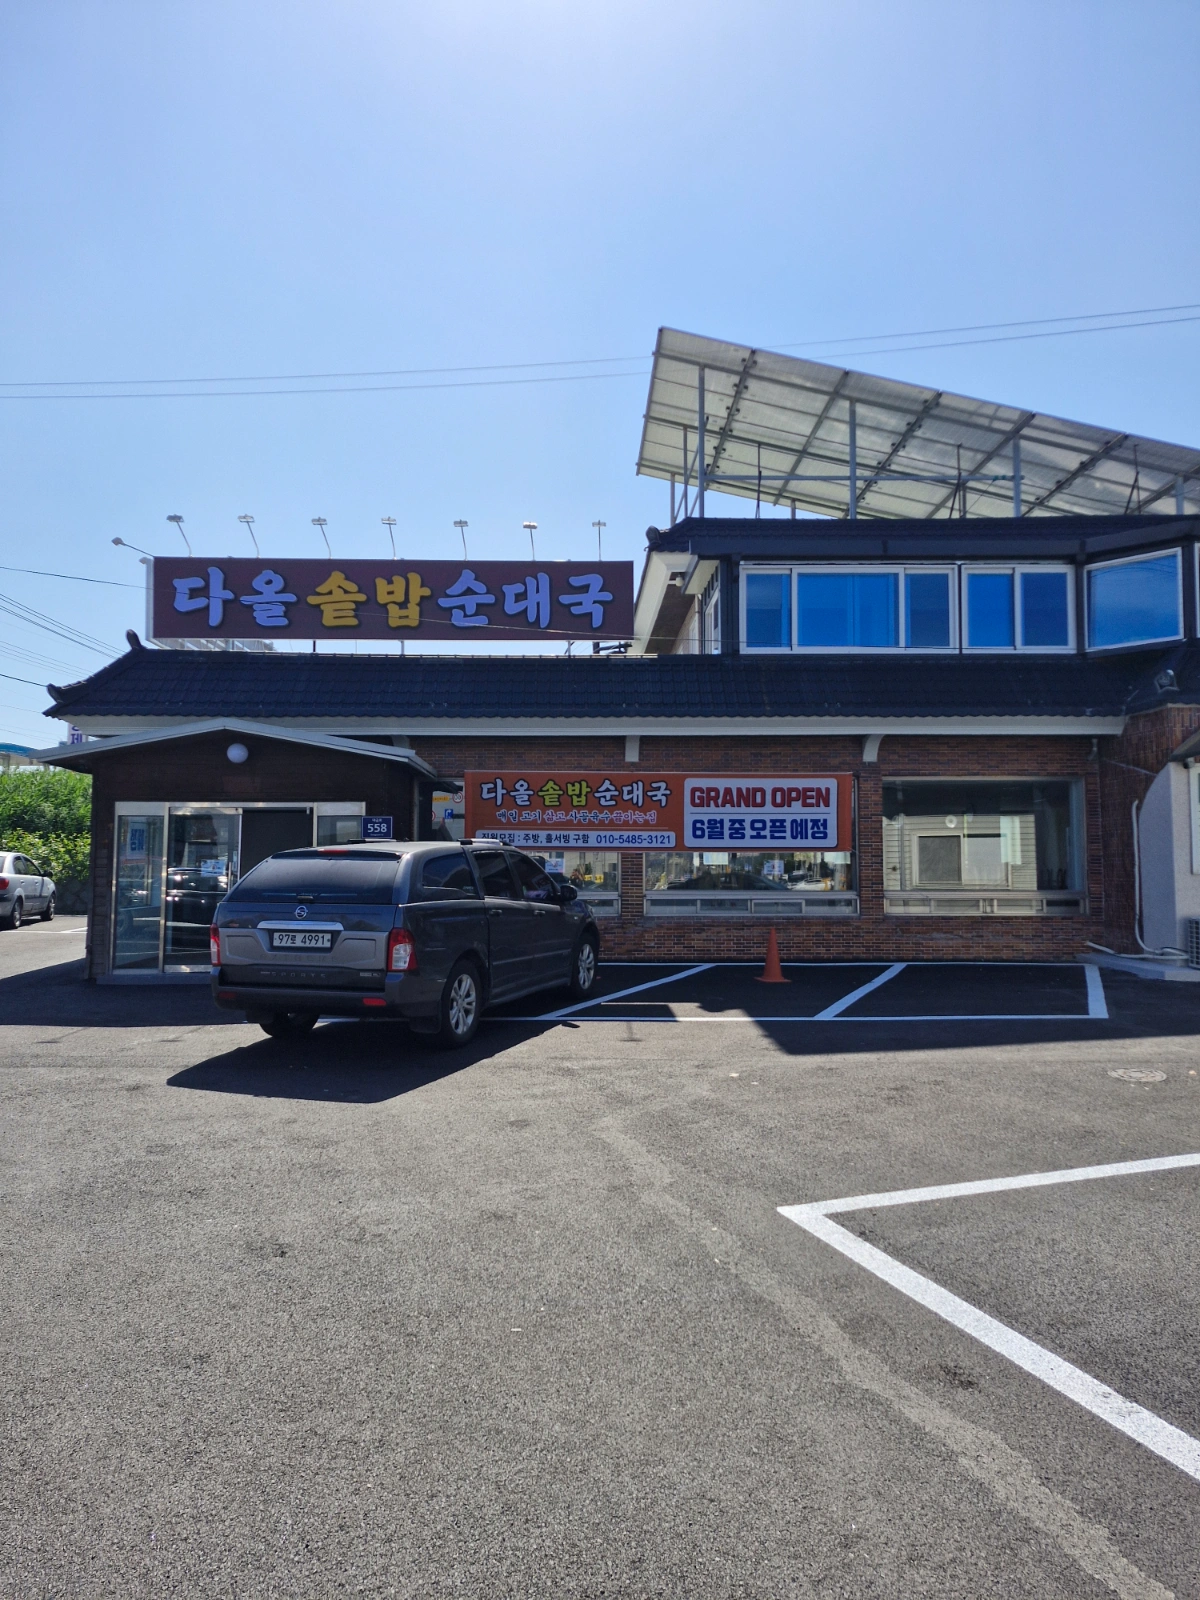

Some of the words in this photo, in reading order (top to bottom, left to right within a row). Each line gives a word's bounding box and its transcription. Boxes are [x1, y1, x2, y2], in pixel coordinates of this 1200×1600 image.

[172, 566, 614, 629] 다올솥밥순대국
[480, 778, 671, 807] 다올솥밥순대국
[690, 786, 766, 808] GRAND
[771, 786, 831, 808] OPEN
[496, 810, 518, 823] 매일
[520, 810, 542, 823] 고기
[567, 810, 612, 824] 사골육수
[367, 823, 387, 833] 558
[692, 818, 725, 840] 6월
[728, 818, 746, 840] 중
[749, 818, 787, 840] 오픈
[790, 818, 828, 840] 예정
[522, 833, 543, 844] 주방,
[545, 833, 571, 844] 홀서빙
[573, 833, 590, 844] 구함
[595, 834, 671, 845] 010-5485-3121
[278, 933, 297, 945] 97로
[300, 934, 325, 946] 4991
